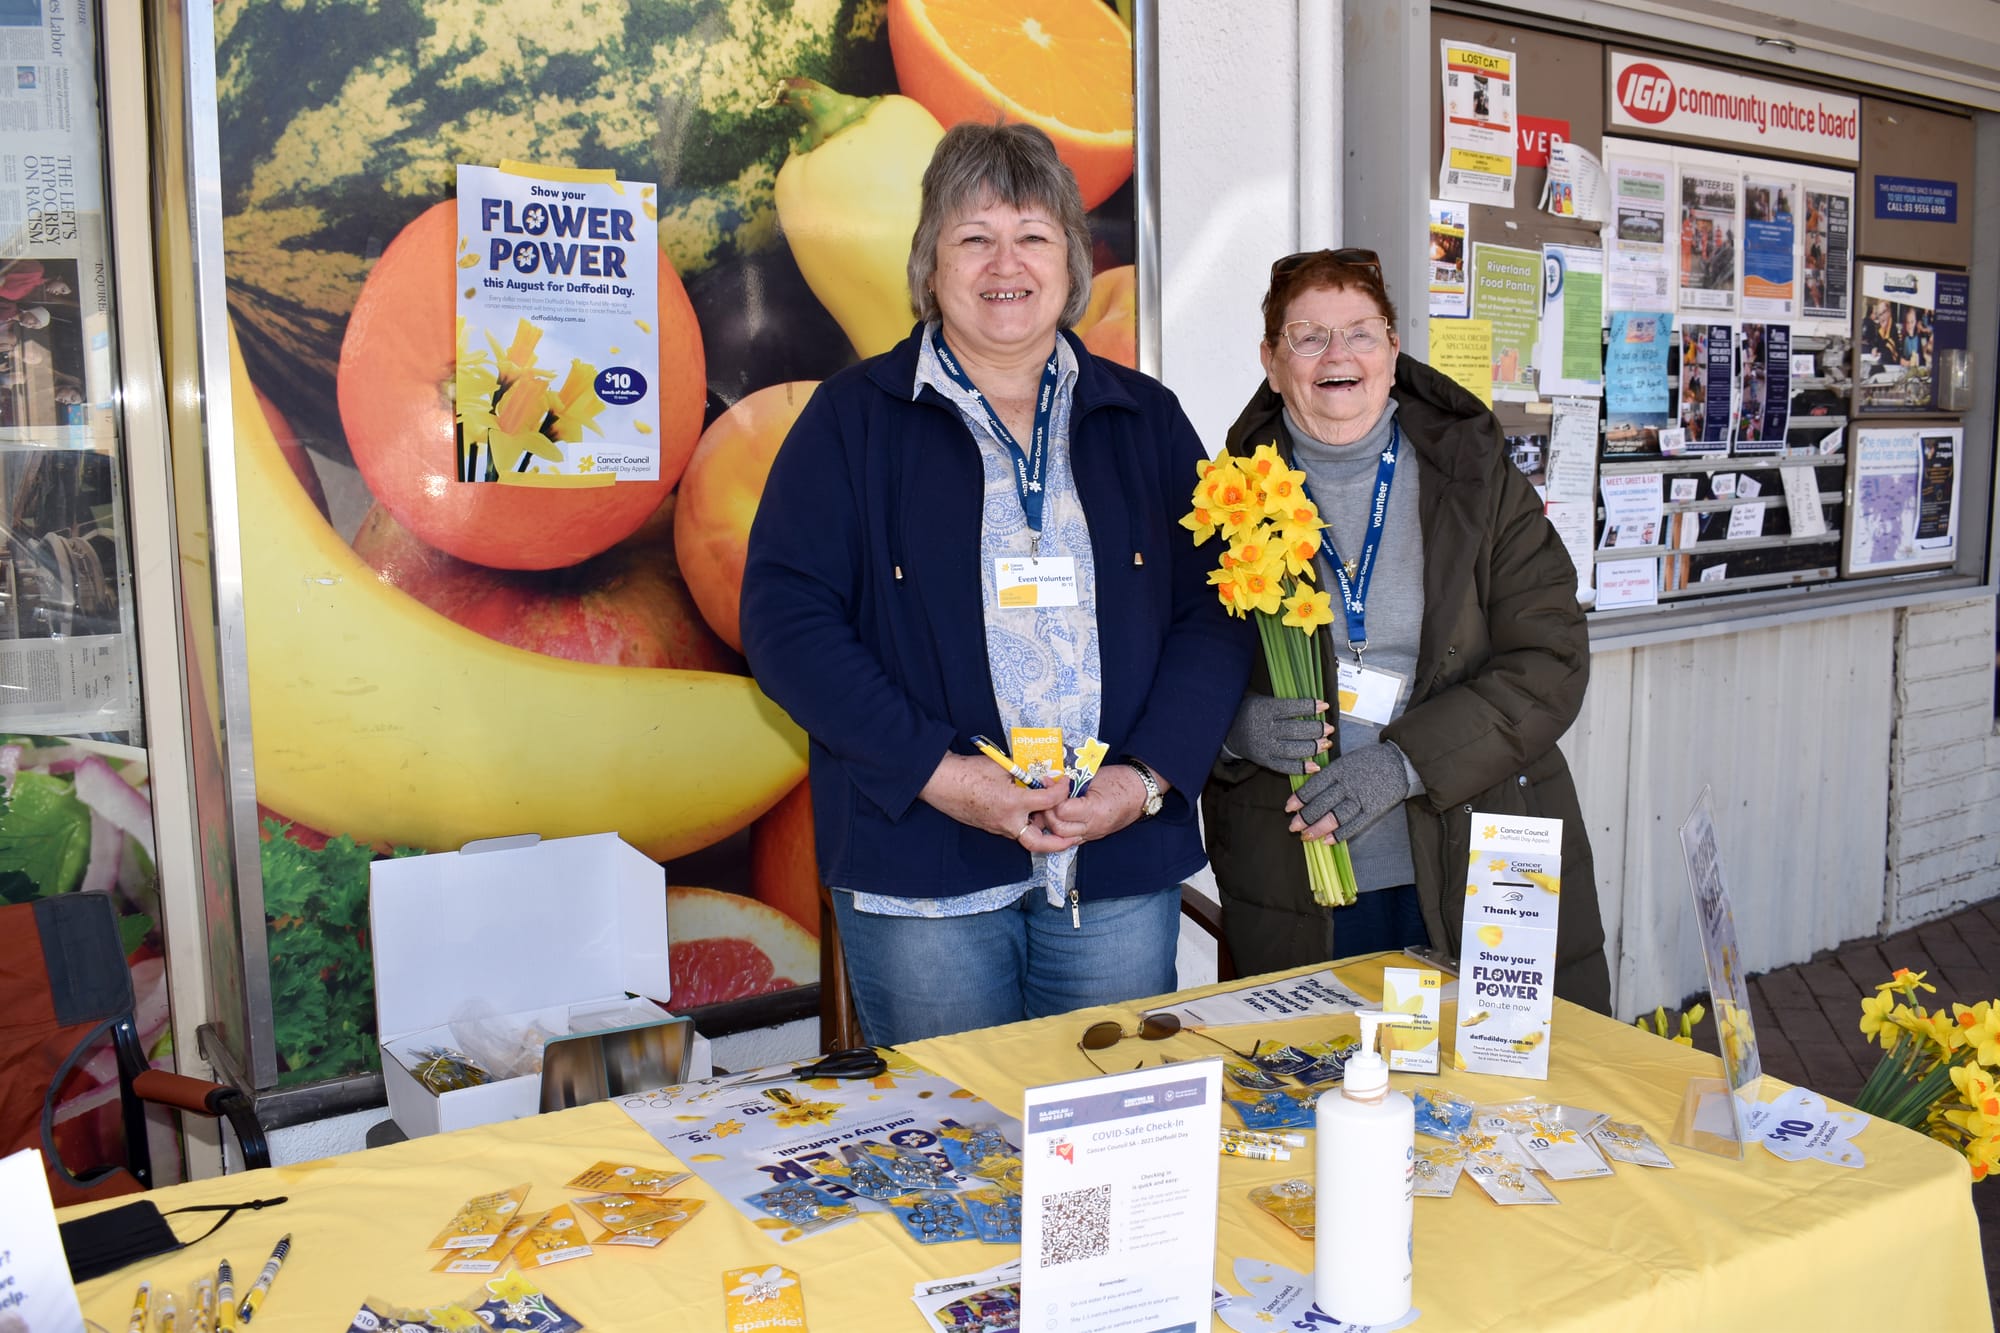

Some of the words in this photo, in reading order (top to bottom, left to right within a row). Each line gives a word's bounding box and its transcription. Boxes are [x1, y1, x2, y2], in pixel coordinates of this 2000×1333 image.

[50, 16, 64, 57] Labor
[1462, 53, 1482, 65] LOST
[1483, 58, 1499, 69] CAT
[1623, 73, 1672, 113] IGA
[1679, 86, 1766, 134] community
[1771, 101, 1815, 133] notice
[1818, 102, 1856, 140] board
[24, 155, 39, 182] ON
[57, 155, 72, 189] THE
[40, 156, 61, 246] HYPOCRISY
[531, 185, 558, 199] Show
[562, 189, 586, 201] your
[26, 185, 44, 246] RACISM
[60, 191, 77, 240] LEFT'S
[481, 198, 635, 242] FLOWER
[489, 237, 627, 278] POWER
[1487, 261, 1531, 277] Riverland
[484, 277, 505, 290] this
[507, 278, 545, 293] August
[547, 280, 564, 292] for
[567, 282, 609, 295] Daffodil
[612, 285, 636, 298] Day.
[1480, 276, 1503, 289] Food
[1505, 279, 1536, 296] Pantry
[531, 314, 586, 323] daffodilday.com.au
[937, 347, 960, 378] volunteer
[605, 372, 631, 389] $10
[1040, 384, 1051, 413] volunteer
[1037, 426, 1044, 436] SA
[1034, 436, 1043, 457] Council
[597, 456, 622, 464] Cancer
[623, 456, 649, 464] Council
[1033, 457, 1041, 480] Cancer
[1017, 458, 1028, 497] voluntee
[1372, 480, 1388, 529] volunteer
[1018, 575, 1037, 583] Event
[1356, 575, 1365, 599] Cancer
[1361, 553, 1371, 575] Council
[1367, 544, 1373, 554] SA
[1524, 828, 1549, 837] Council
[1511, 860, 1542, 868] Cancer
[1511, 866, 1543, 874] Council
[1483, 905, 1517, 916] Thank
[1519, 908, 1539, 918] you
[1479, 951, 1508, 963] Show
[1510, 955, 1537, 966] your
[1472, 966, 1543, 986] FLOWER
[1265, 989, 1309, 1011] Research
[1295, 985, 1325, 998] gives
[1305, 978, 1323, 989] The
[1322, 988, 1364, 1007] daffodil
[1475, 982, 1538, 1001] POWER
[1260, 995, 1293, 1014] saving
[1478, 999, 1510, 1011] Donate
[1512, 1003, 1532, 1013] now
[1469, 1034, 1534, 1045] daffodilday.com.au
[742, 1106, 776, 1117] $10
[853, 1124, 885, 1138] buy
[889, 1117, 915, 1131] and
[1092, 1122, 1144, 1142] COVID-Safe
[1146, 1118, 1184, 1132] Check-In
[1484, 1117, 1505, 1127] $10
[1767, 1119, 1815, 1142] $10
[687, 1133, 712, 1144] $5
[772, 1135, 840, 1157] daffodil.
[1086, 1146, 1106, 1155] Cancer
[1107, 1143, 1128, 1151] Council
[1155, 1134, 1177, 1143] Daffodil
[1528, 1138, 1550, 1149] $10
[1141, 1171, 1165, 1181] Checking
[1472, 1166, 1494, 1176] $10
[0, 1291, 29, 1312] elp.
[1263, 1297, 1279, 1313] Cancer
[1275, 1285, 1294, 1301] Council
[356, 1313, 374, 1326] $10
[733, 1317, 804, 1333] sparkle!
[1292, 1301, 1342, 1333] $1
